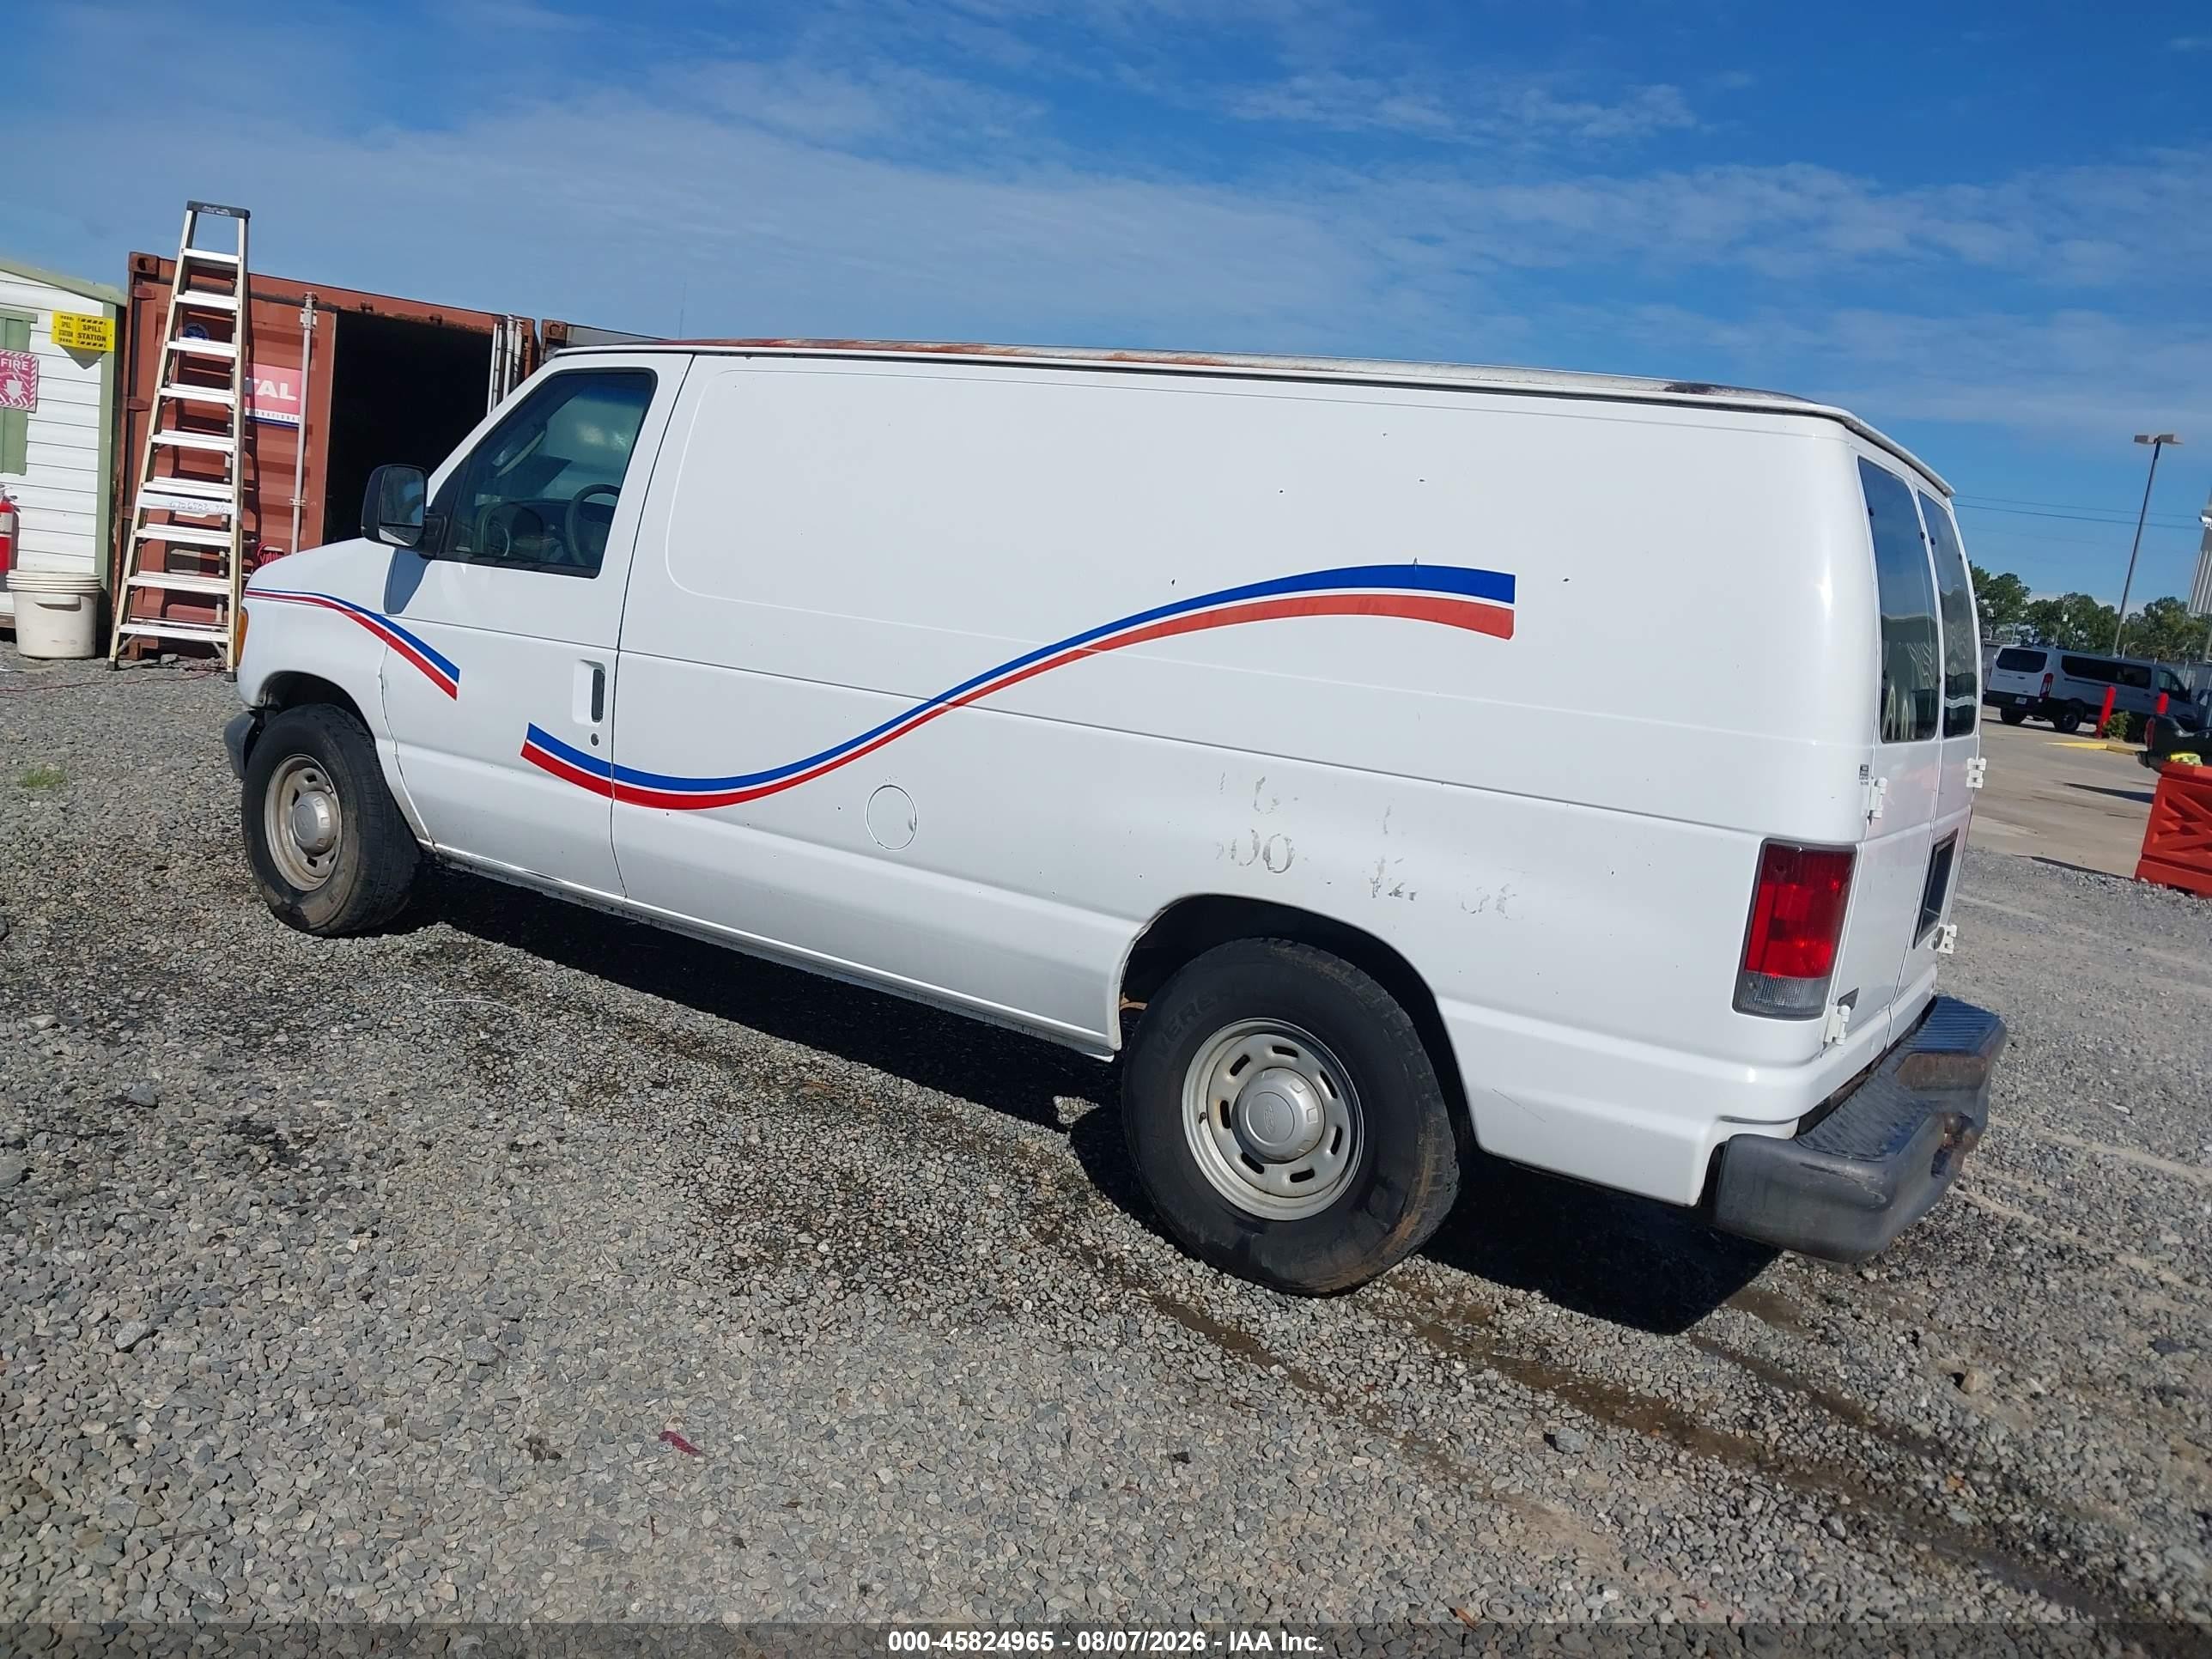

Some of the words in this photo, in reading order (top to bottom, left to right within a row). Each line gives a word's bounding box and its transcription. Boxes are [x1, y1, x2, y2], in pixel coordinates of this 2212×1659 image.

[82, 324, 102, 333] SPILL
[77, 332, 106, 342] STATION
[1, 358, 29, 371] FIRE
